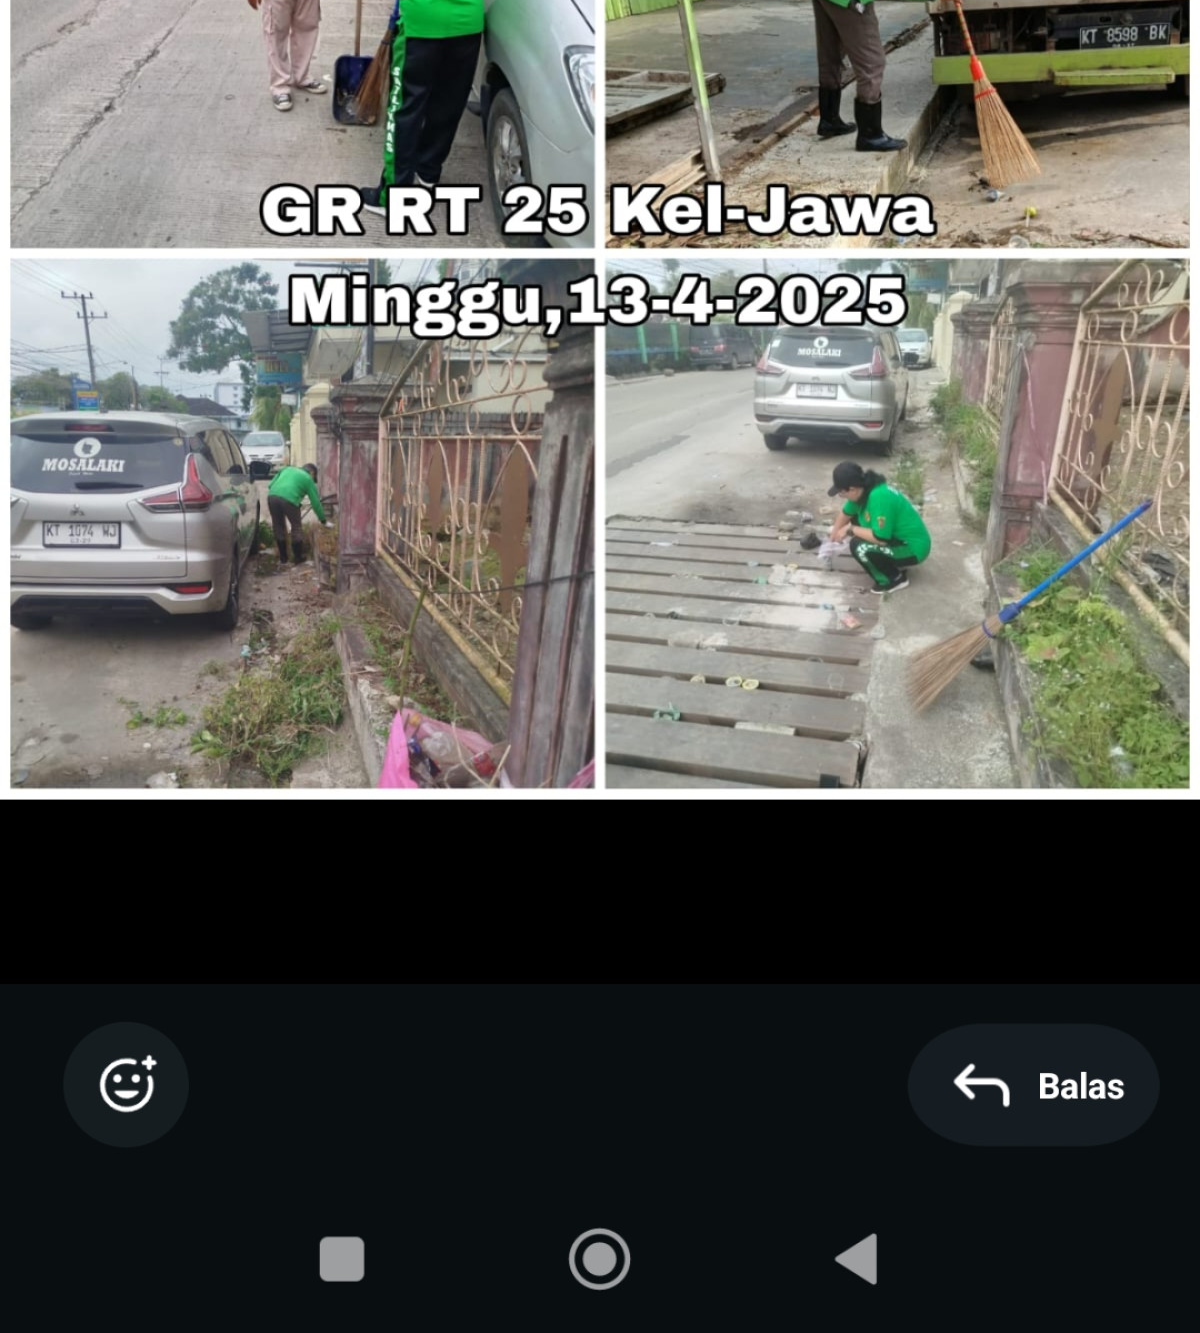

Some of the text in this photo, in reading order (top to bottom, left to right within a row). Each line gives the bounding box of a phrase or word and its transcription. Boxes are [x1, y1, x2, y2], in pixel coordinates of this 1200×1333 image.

[1081, 24, 1168, 45] KT 8598 BK
[797, 348, 841, 357] MOSALAKI
[42, 458, 125, 473] MOSALAKI
[46, 523, 117, 537] KT 1074 WJ
[1039, 1071, 1125, 1100] Balas
